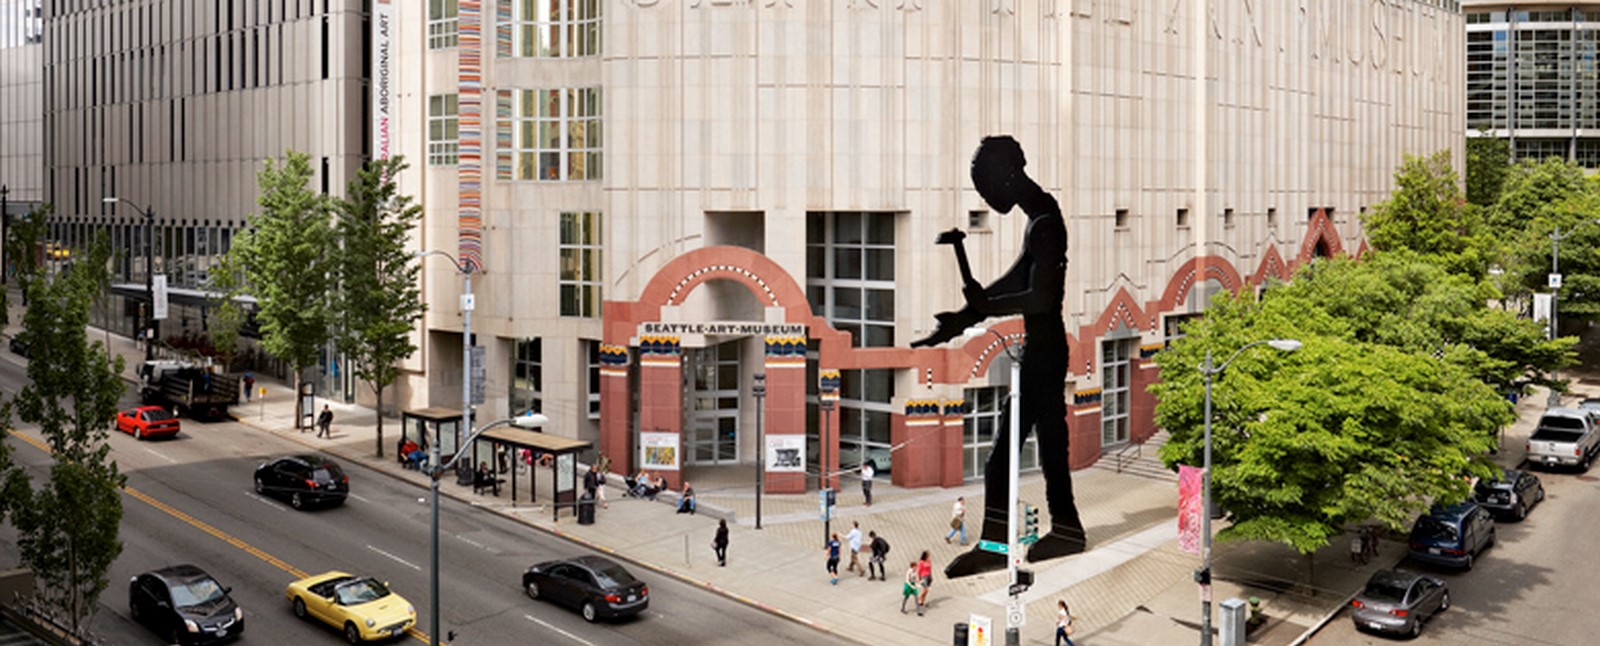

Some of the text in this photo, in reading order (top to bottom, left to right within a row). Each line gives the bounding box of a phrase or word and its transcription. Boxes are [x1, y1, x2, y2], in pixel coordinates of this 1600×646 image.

[380, 14, 389, 37] ART
[379, 41, 389, 115] ABORIGINAL
[645, 323, 802, 335] SEATTLE ART MUSEUM
